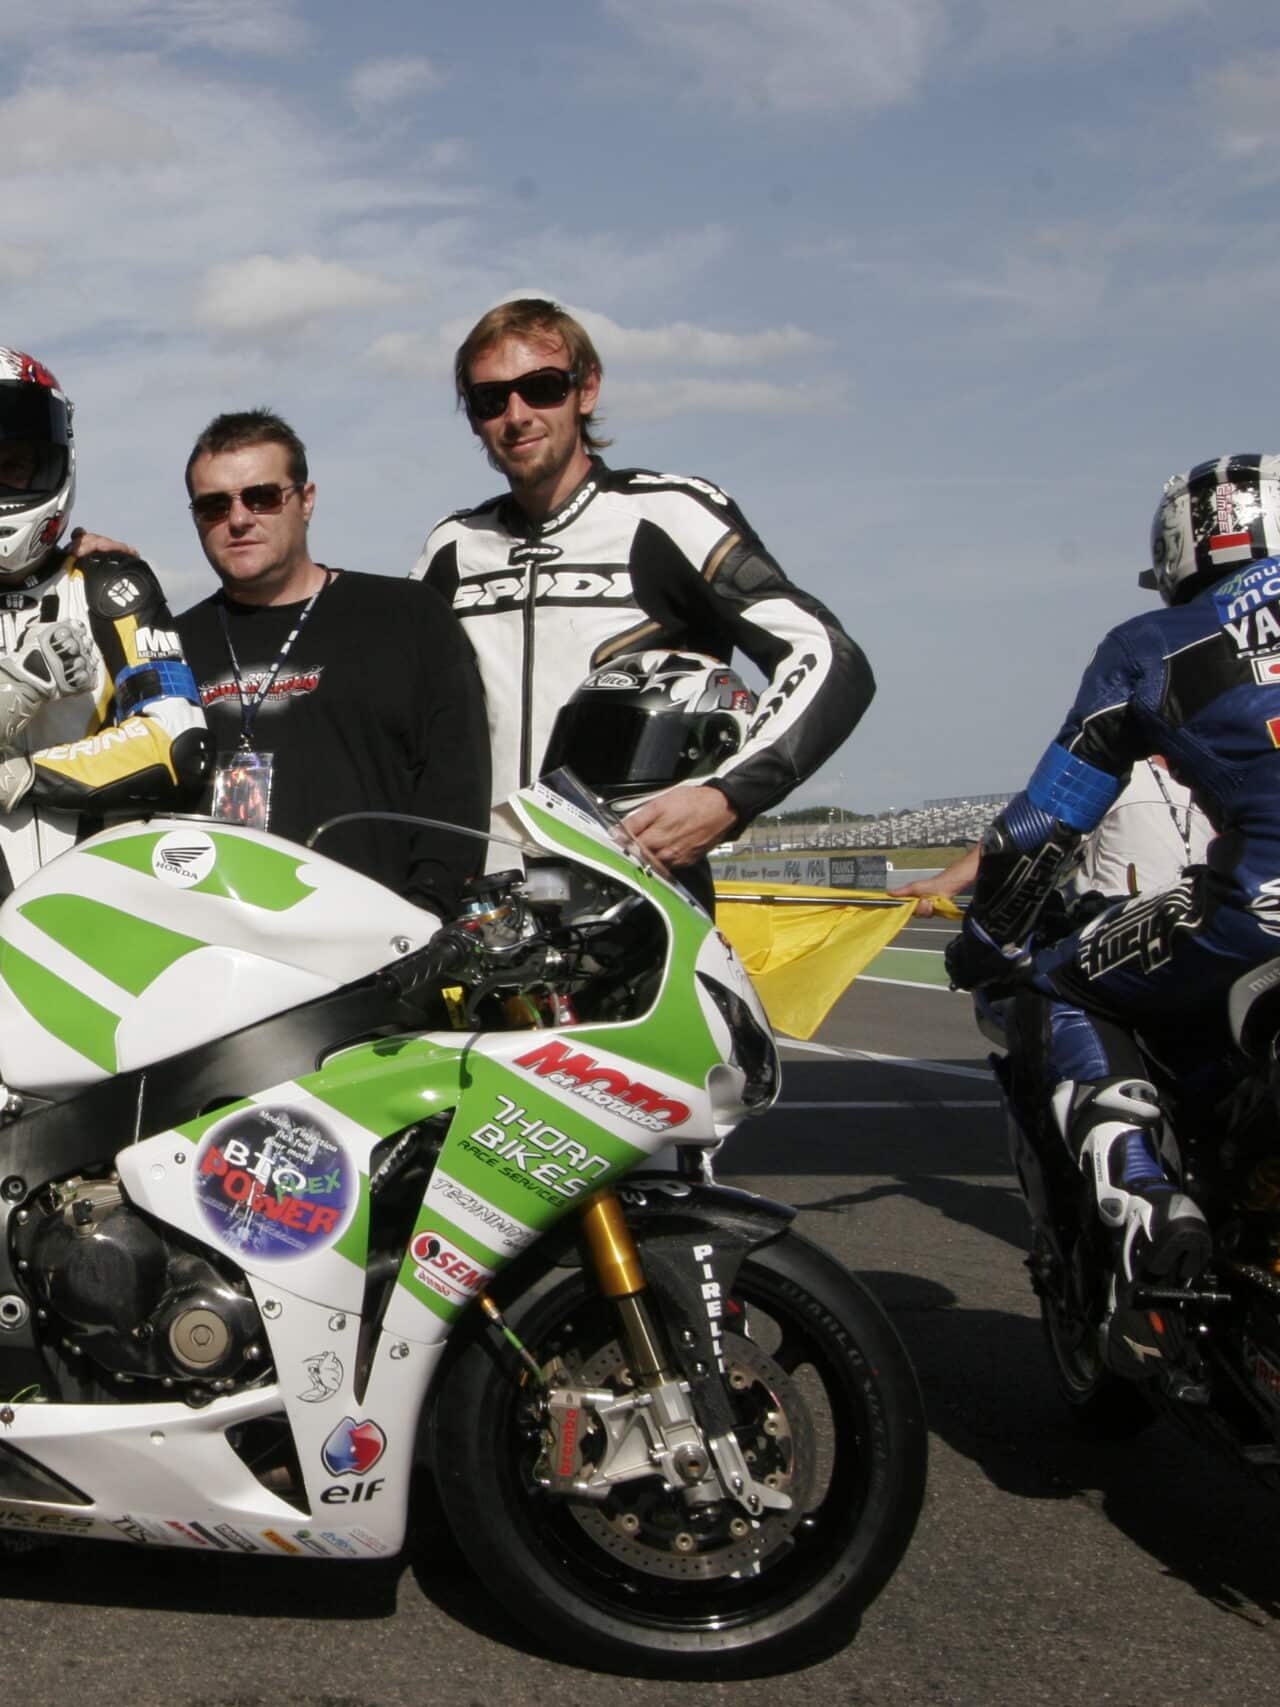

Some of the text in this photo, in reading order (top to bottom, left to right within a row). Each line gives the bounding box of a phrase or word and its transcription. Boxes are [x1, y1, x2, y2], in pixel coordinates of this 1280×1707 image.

[452, 572, 634, 609] SPIDI
[135, 626, 181, 652] MI
[1223, 605, 1280, 650] YA
[155, 861, 199, 880] HONDA
[513, 1040, 692, 1129] MOTO
[573, 1083, 670, 1132] MOTARDS
[457, 1139, 502, 1169] RACE
[470, 1123, 591, 1198] BIKES
[493, 1095, 612, 1180] THORN
[200, 1145, 341, 1234] POWER
[223, 1139, 307, 1193] BIO
[430, 1251, 487, 1291] SEM
[692, 1244, 725, 1374] PIRELLI
[559, 1408, 578, 1476] brembo
[320, 1478, 386, 1505] elf
